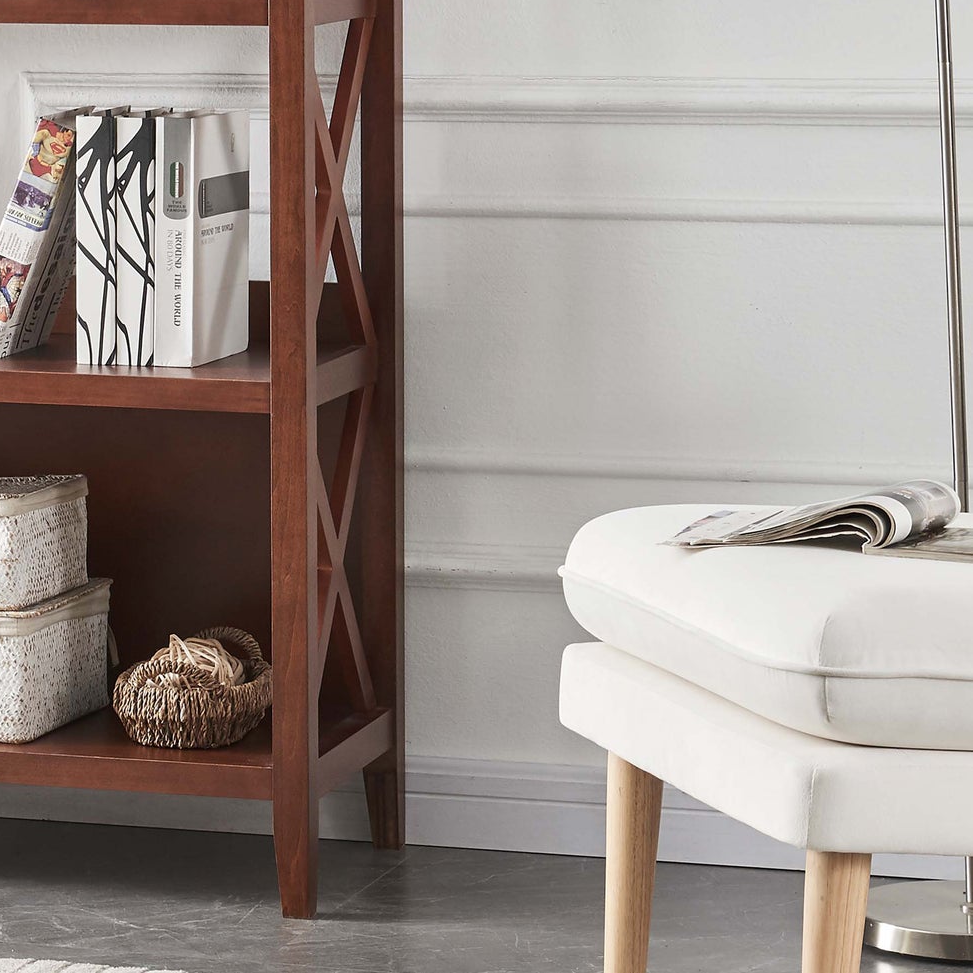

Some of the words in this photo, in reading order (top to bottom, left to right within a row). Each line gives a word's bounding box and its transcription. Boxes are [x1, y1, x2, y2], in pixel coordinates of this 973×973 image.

[174, 230, 183, 270] AROUND
[174, 273, 182, 290] THE
[173, 293, 182, 327] WORLD
